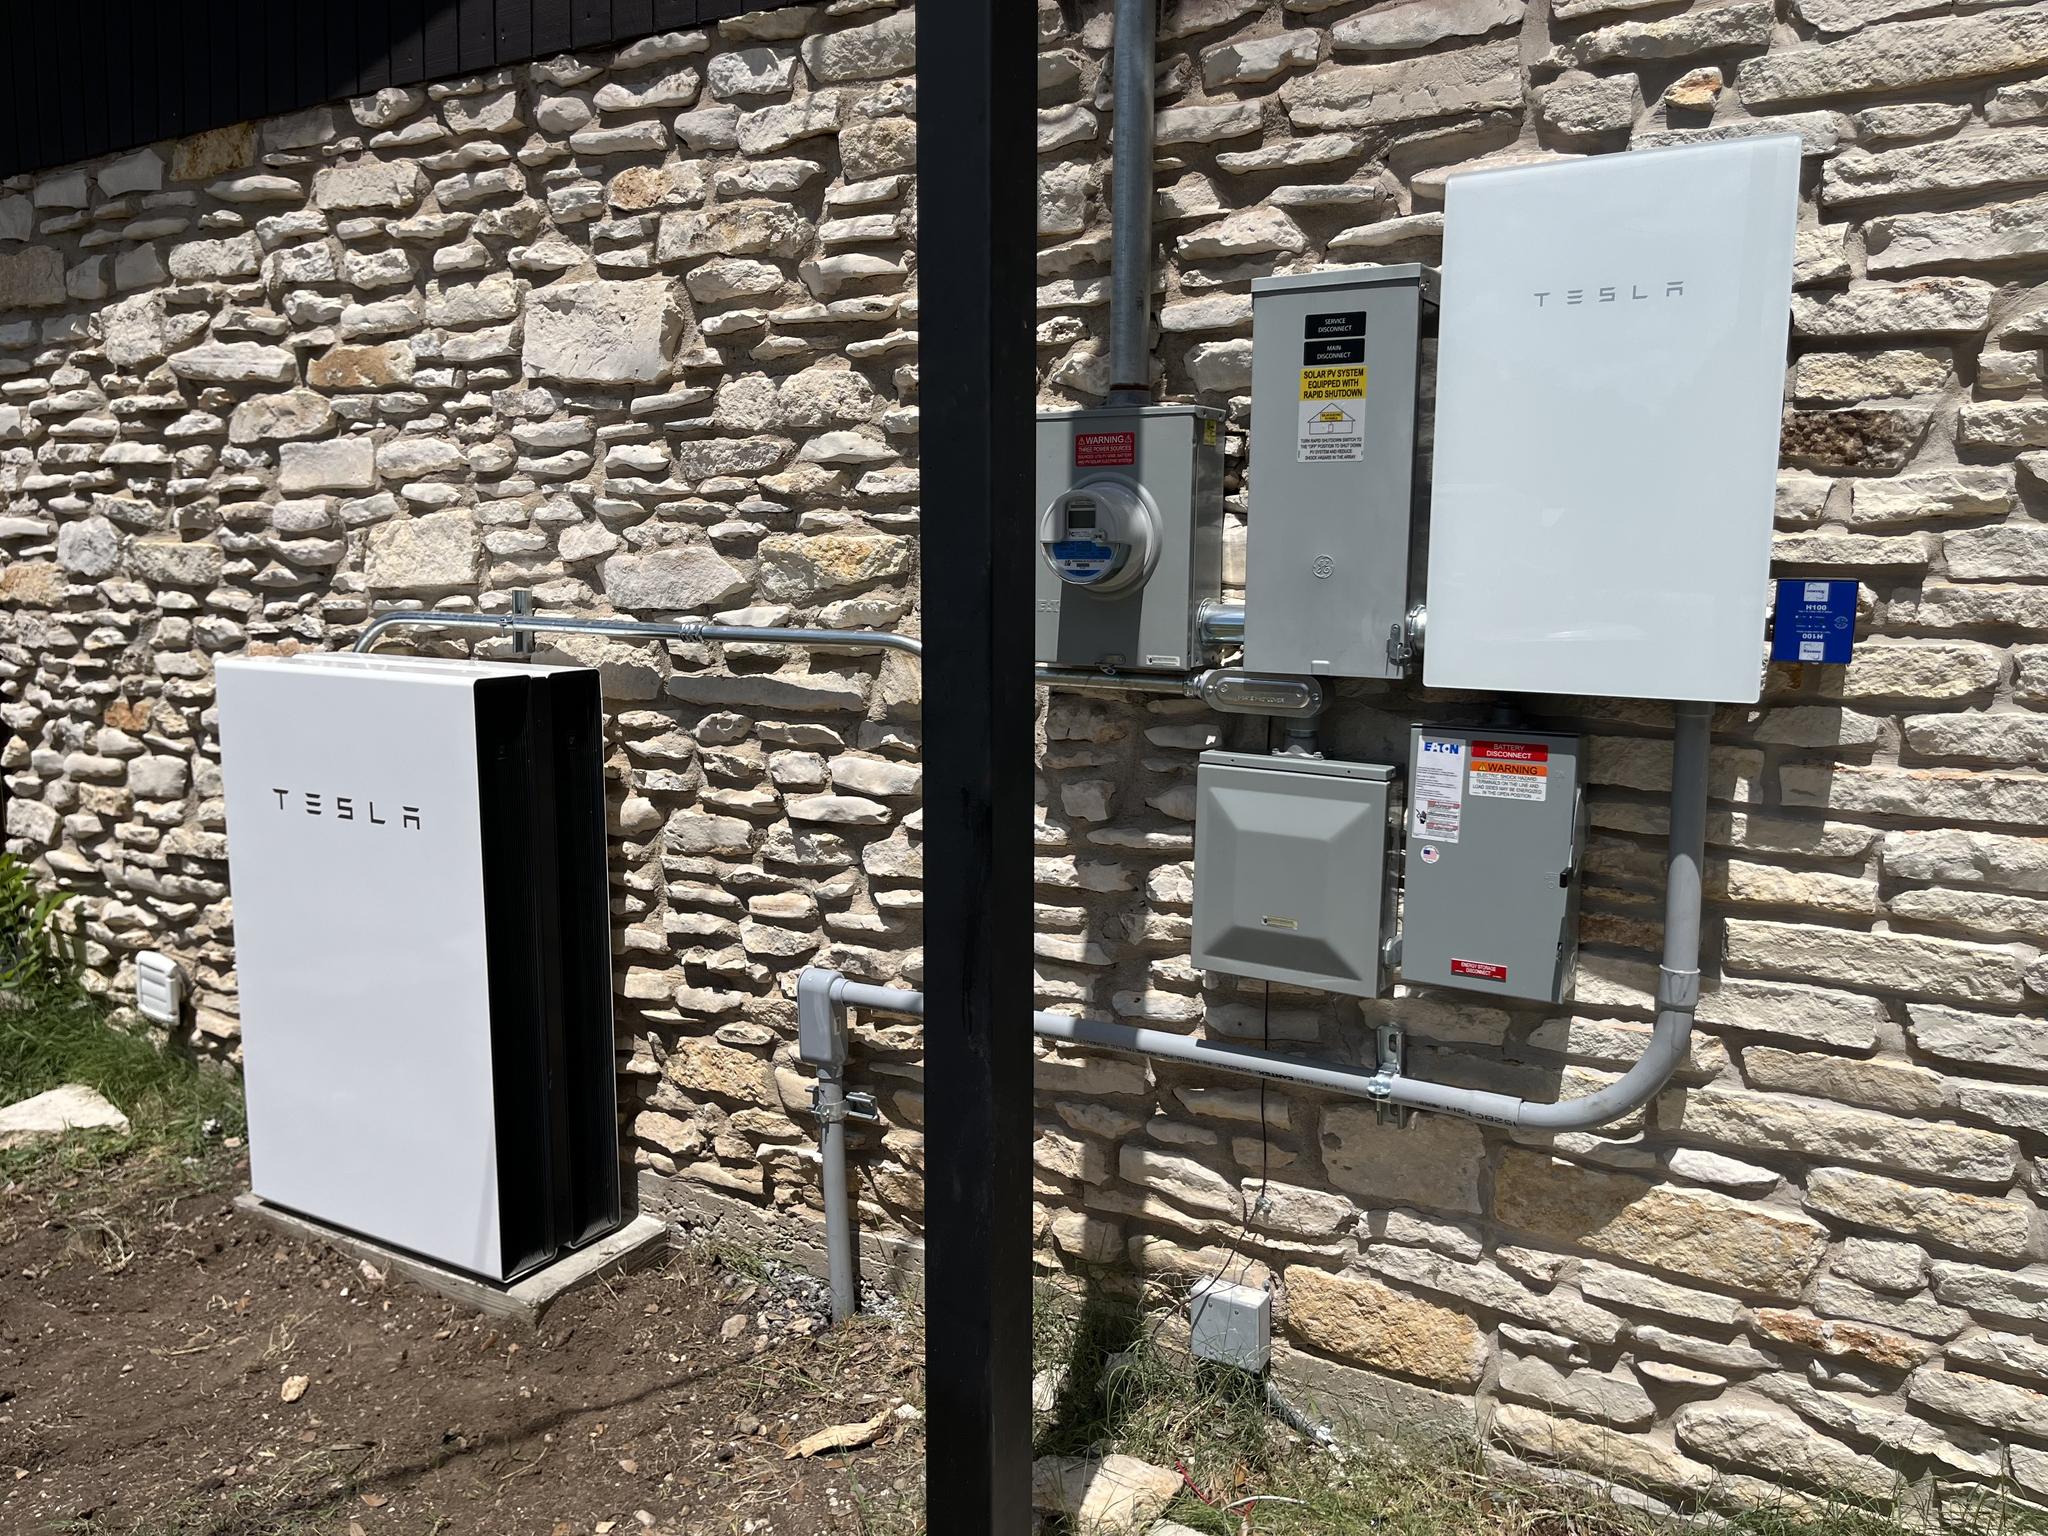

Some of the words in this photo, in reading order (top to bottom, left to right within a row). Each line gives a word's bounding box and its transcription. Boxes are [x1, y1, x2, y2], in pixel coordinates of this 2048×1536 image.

[1533, 281, 1684, 307] TESLA
[1324, 317, 1346, 325] SERVICE
[1317, 325, 1352, 333] DISCONNECT
[1316, 352, 1351, 360] DISCONNECT
[1303, 370, 1326, 379] SOLAR
[1327, 369, 1337, 378] PV
[1337, 368, 1364, 377] SYSTEM
[1308, 380, 1340, 389] EQUIPPED
[1342, 378, 1359, 387] WITH
[1303, 390, 1323, 399] RAPID
[1325, 388, 1363, 398] SHUTDOWN
[1085, 435, 1124, 444] WARNING
[1424, 742, 1459, 755] EATON
[1486, 750, 1532, 759] DISCONNECT
[1487, 763, 1538, 775] WARNING
[272, 788, 420, 830] TESLA
